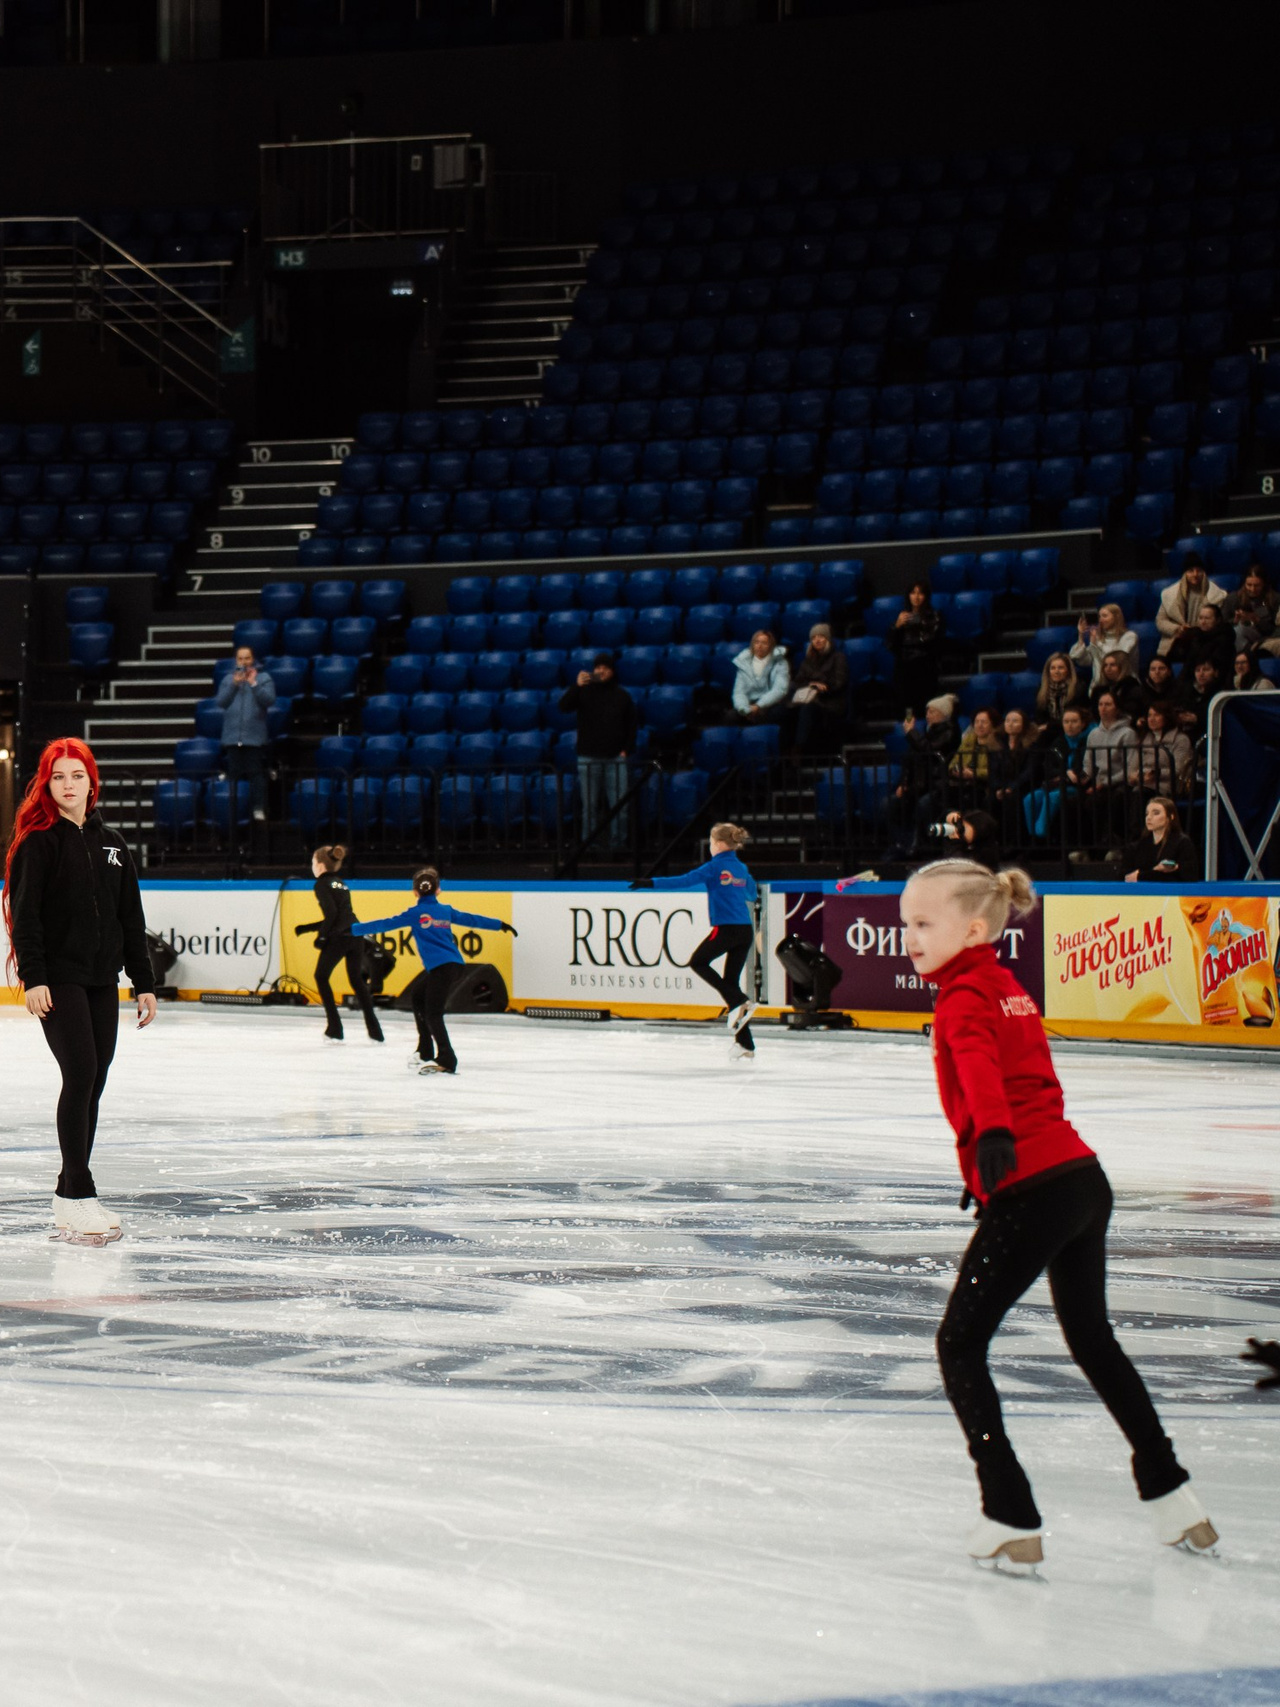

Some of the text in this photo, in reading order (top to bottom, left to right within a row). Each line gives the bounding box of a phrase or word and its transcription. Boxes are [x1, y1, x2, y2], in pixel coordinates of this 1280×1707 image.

[252, 444, 351, 463] 10 10
[1261, 475, 1275, 495] 8
[231, 489, 245, 505] 9
[210, 533, 224, 549] 8
[191, 575, 204, 592] 7
[568, 908, 694, 969] RRCC
[1054, 922, 1107, 956] Знаем,
[1060, 913, 1165, 984] любим
[1099, 936, 1172, 990] и едим!
[1203, 930, 1268, 1000] ДЖИНН
[570, 975, 694, 990] BUSINESS CLUB
